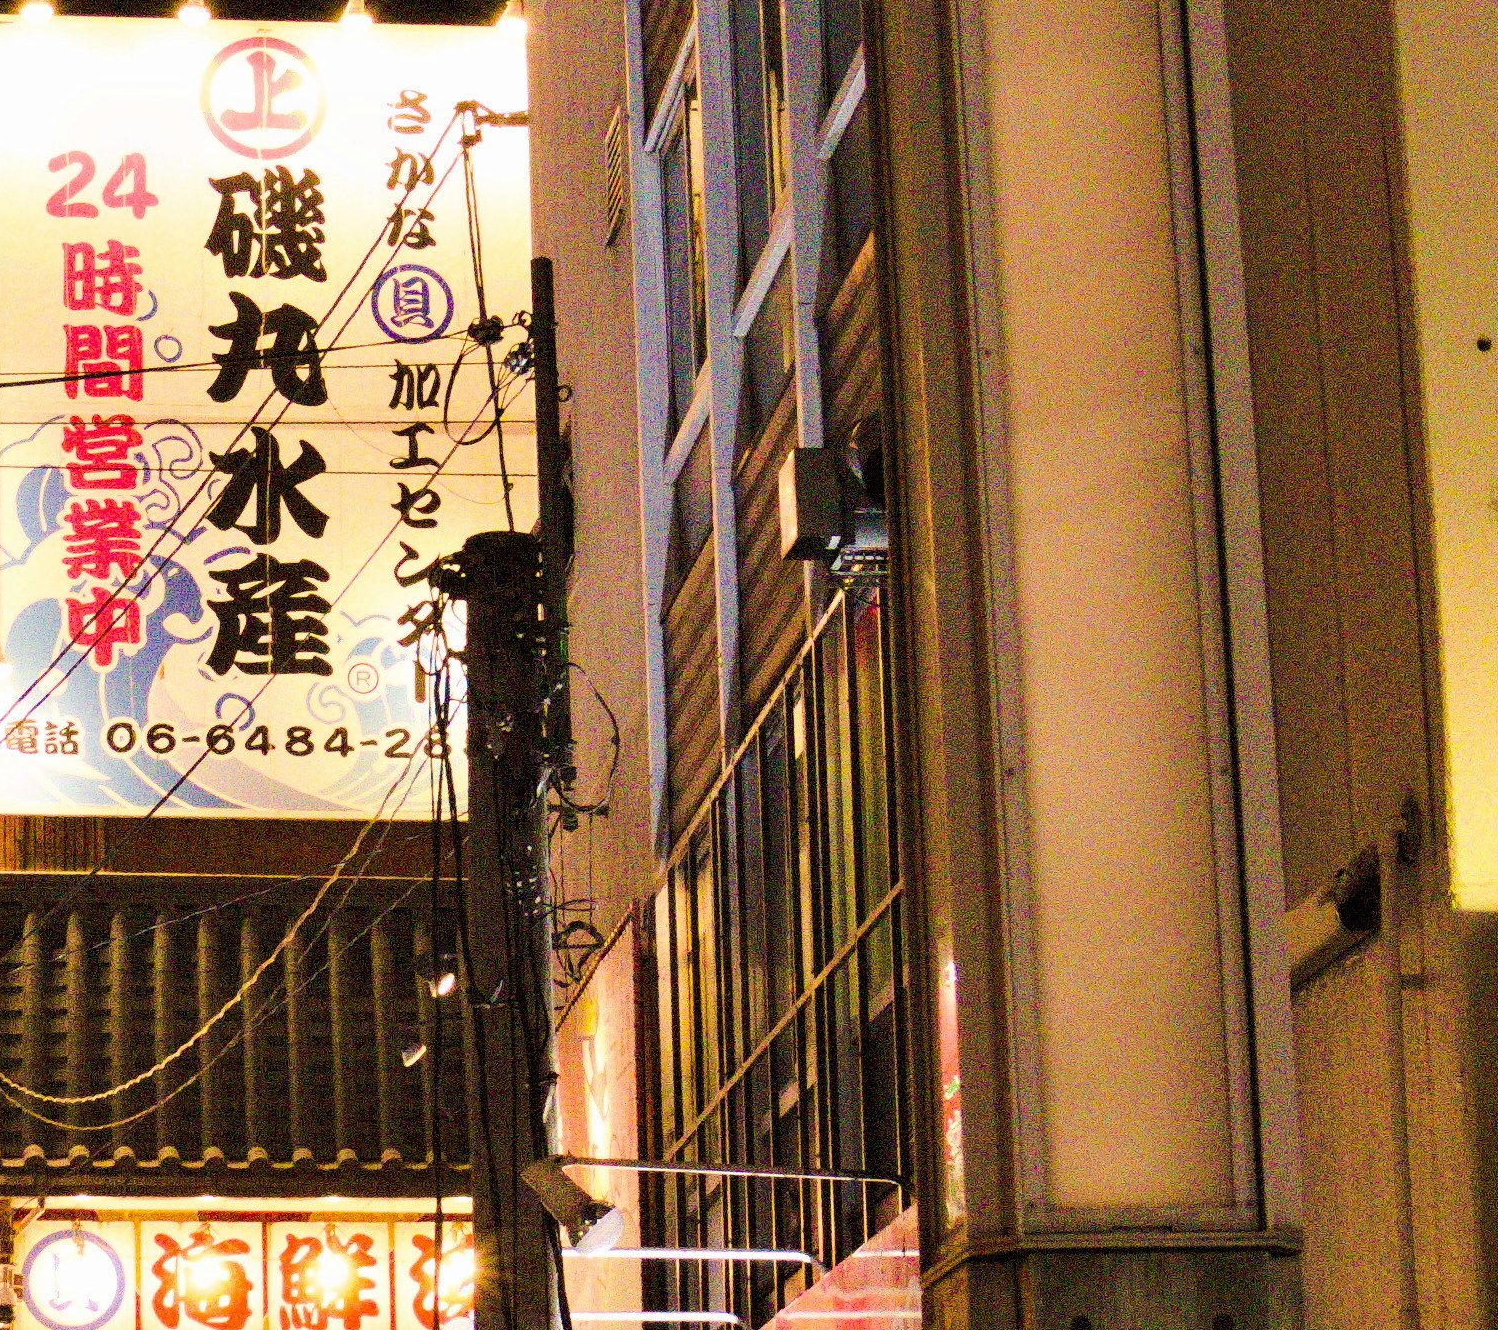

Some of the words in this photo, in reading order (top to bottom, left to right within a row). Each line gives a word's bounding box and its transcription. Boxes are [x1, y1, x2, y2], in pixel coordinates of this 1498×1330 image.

[221, 50, 305, 131] 上
[204, 165, 333, 677] 磯丸水産
[4, 721, 79, 756] 電話
